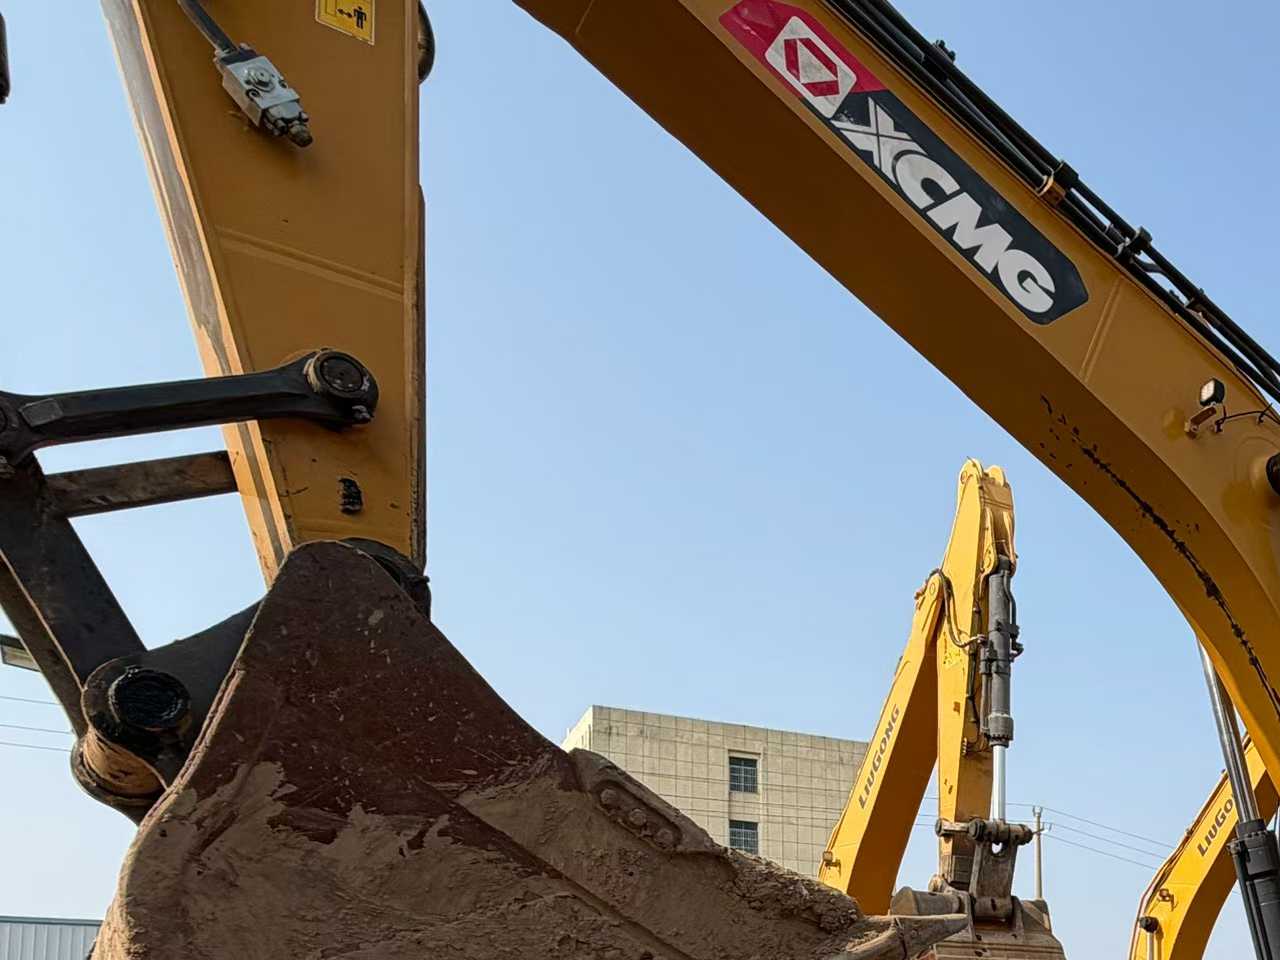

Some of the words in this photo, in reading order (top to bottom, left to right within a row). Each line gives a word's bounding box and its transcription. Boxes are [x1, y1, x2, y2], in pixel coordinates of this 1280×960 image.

[830, 96, 1056, 313] XCMG
[859, 703, 900, 809] LIUGONG
[1197, 798, 1234, 857] LIUGO
